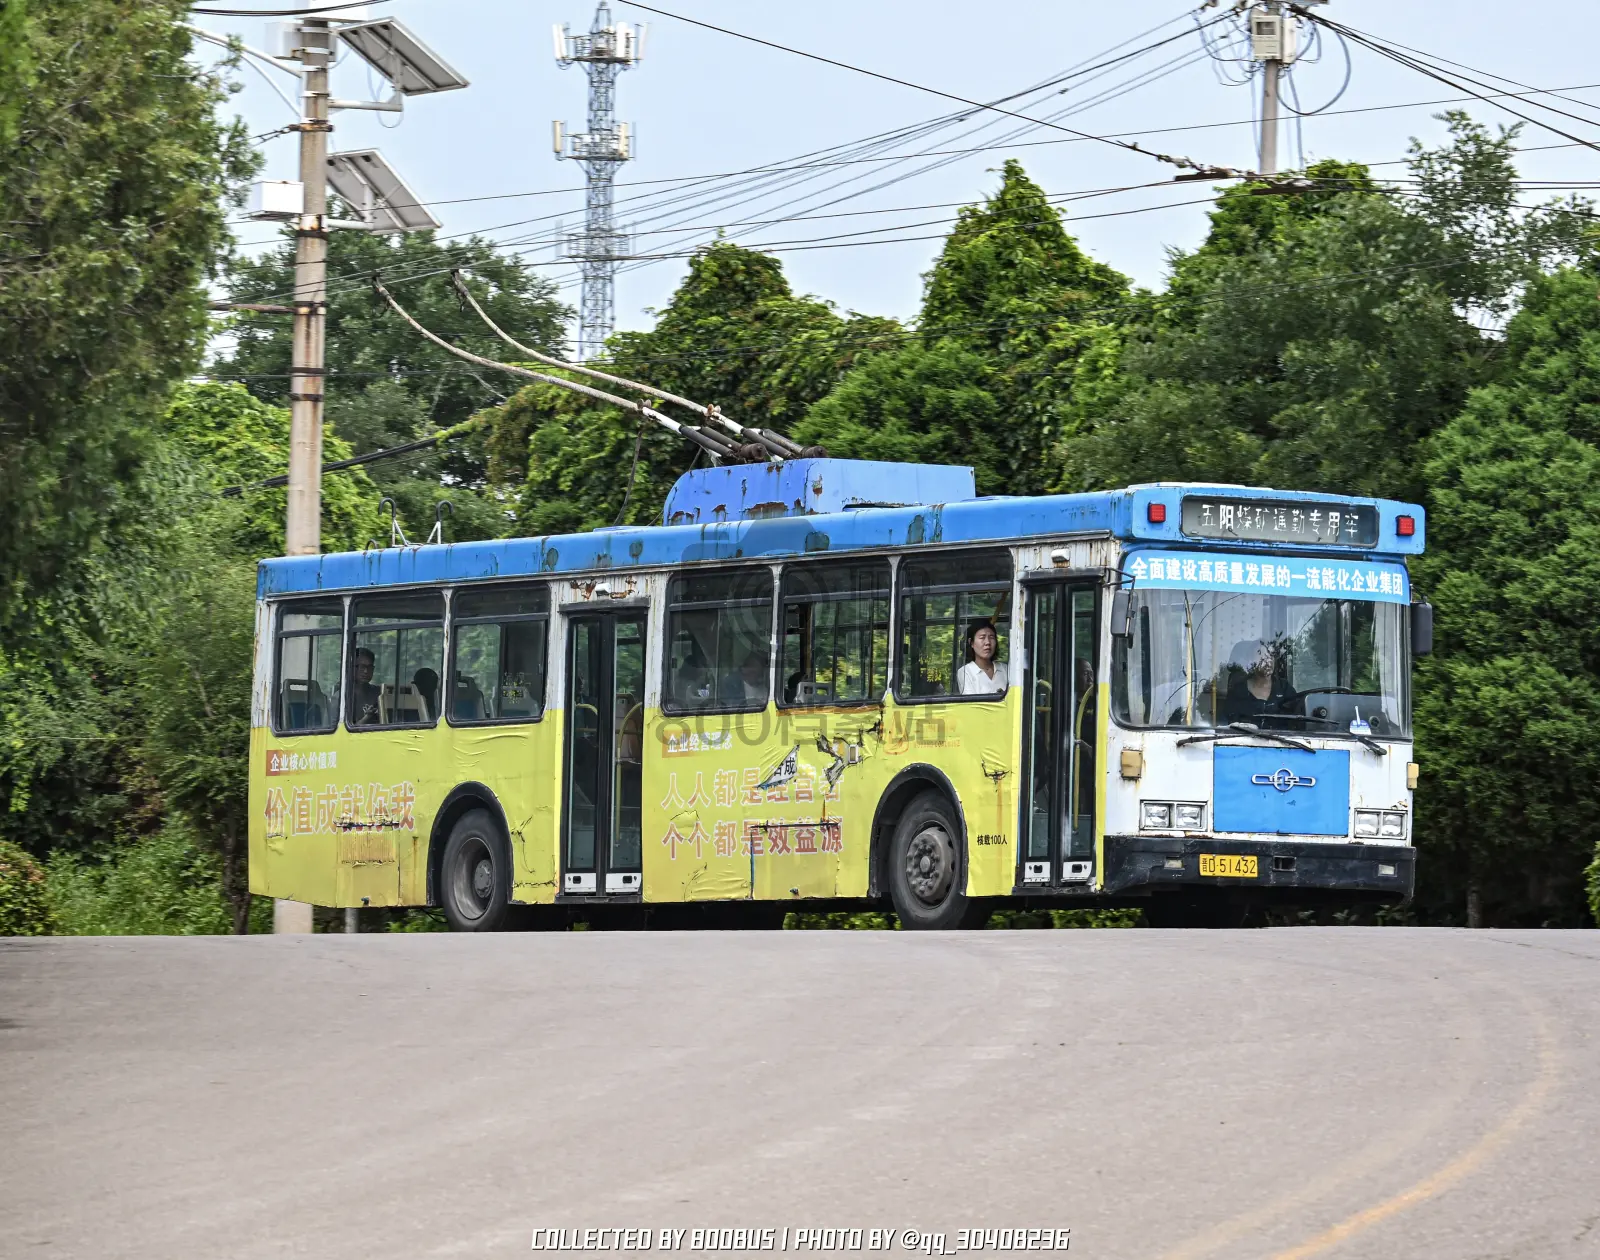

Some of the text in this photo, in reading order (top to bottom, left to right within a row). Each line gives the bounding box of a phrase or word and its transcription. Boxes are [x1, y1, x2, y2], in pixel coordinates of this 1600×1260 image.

[1201, 503, 1359, 538] 五阳煤矿通勤专用车
[1130, 556, 1404, 597] 全面建设高质量发展的一流能化企业集团
[270, 751, 337, 772] 企业核心价值观
[264, 781, 416, 839] 价值成就你我
[662, 816, 844, 860] 个个都是效益源
[977, 834, 1008, 846] 核载100人
